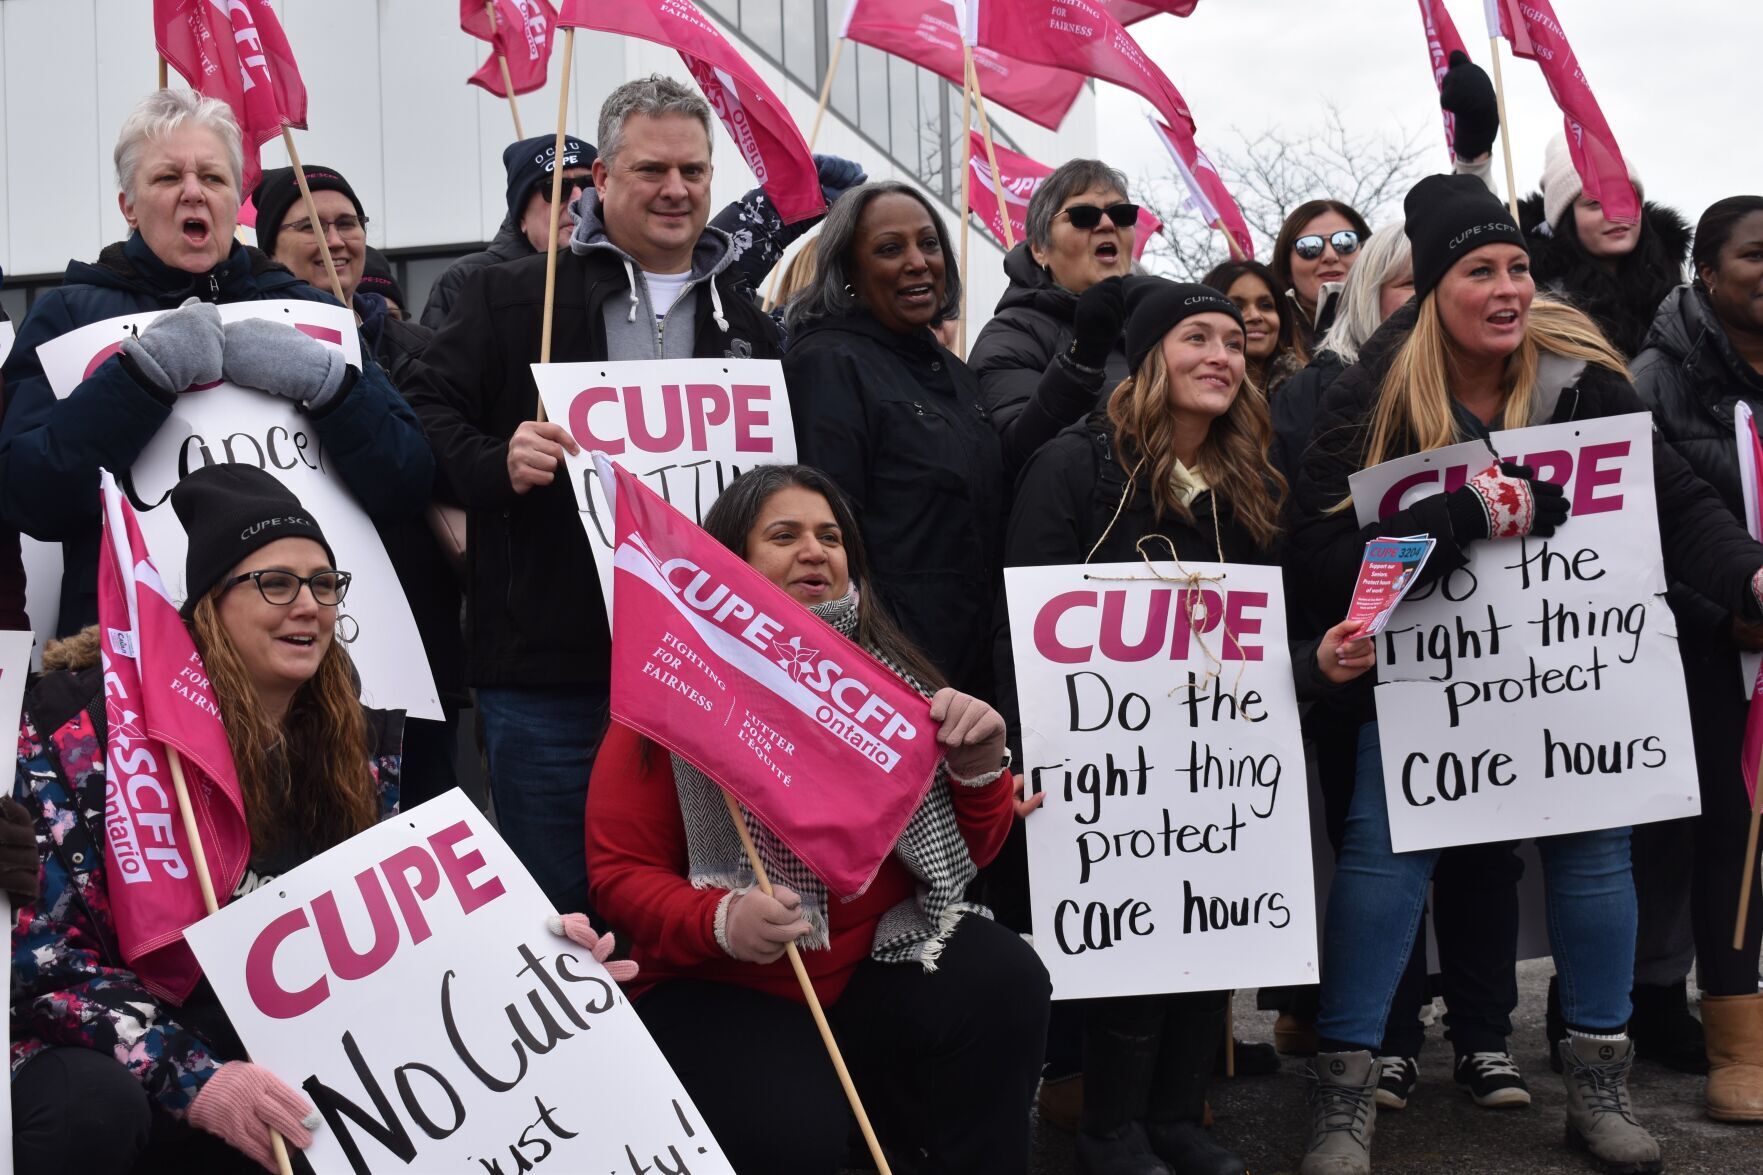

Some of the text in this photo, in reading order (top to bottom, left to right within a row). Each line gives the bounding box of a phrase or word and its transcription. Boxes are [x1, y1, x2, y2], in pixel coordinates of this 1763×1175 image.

[1050, 18, 1094, 38] FAIRNESS
[1051, 6, 1067, 18] FOR
[568, 383, 774, 457] CUPE
[1504, 535, 1606, 590] the
[658, 557, 785, 651] CUPE
[1033, 588, 1269, 664] CUPE
[1384, 598, 1646, 681] right thing
[179, 666, 211, 691] FOR
[641, 661, 714, 712] FAIRNESS
[652, 646, 683, 671] FOR
[662, 631, 727, 692] FIGHTING
[1444, 646, 1609, 728] protect
[742, 719, 773, 754] POUR
[744, 708, 796, 757] LUTTER
[804, 658, 917, 743] SCFP
[814, 704, 890, 767] Ontario
[1065, 671, 1268, 732] Do the
[1031, 740, 1282, 825] right thing
[1401, 728, 1667, 807] care hours
[113, 745, 189, 880] SCFP
[1076, 802, 1246, 885] protect
[245, 819, 507, 1020] CUPE
[1054, 880, 1291, 956] care hours
[301, 1029, 466, 1175] No
